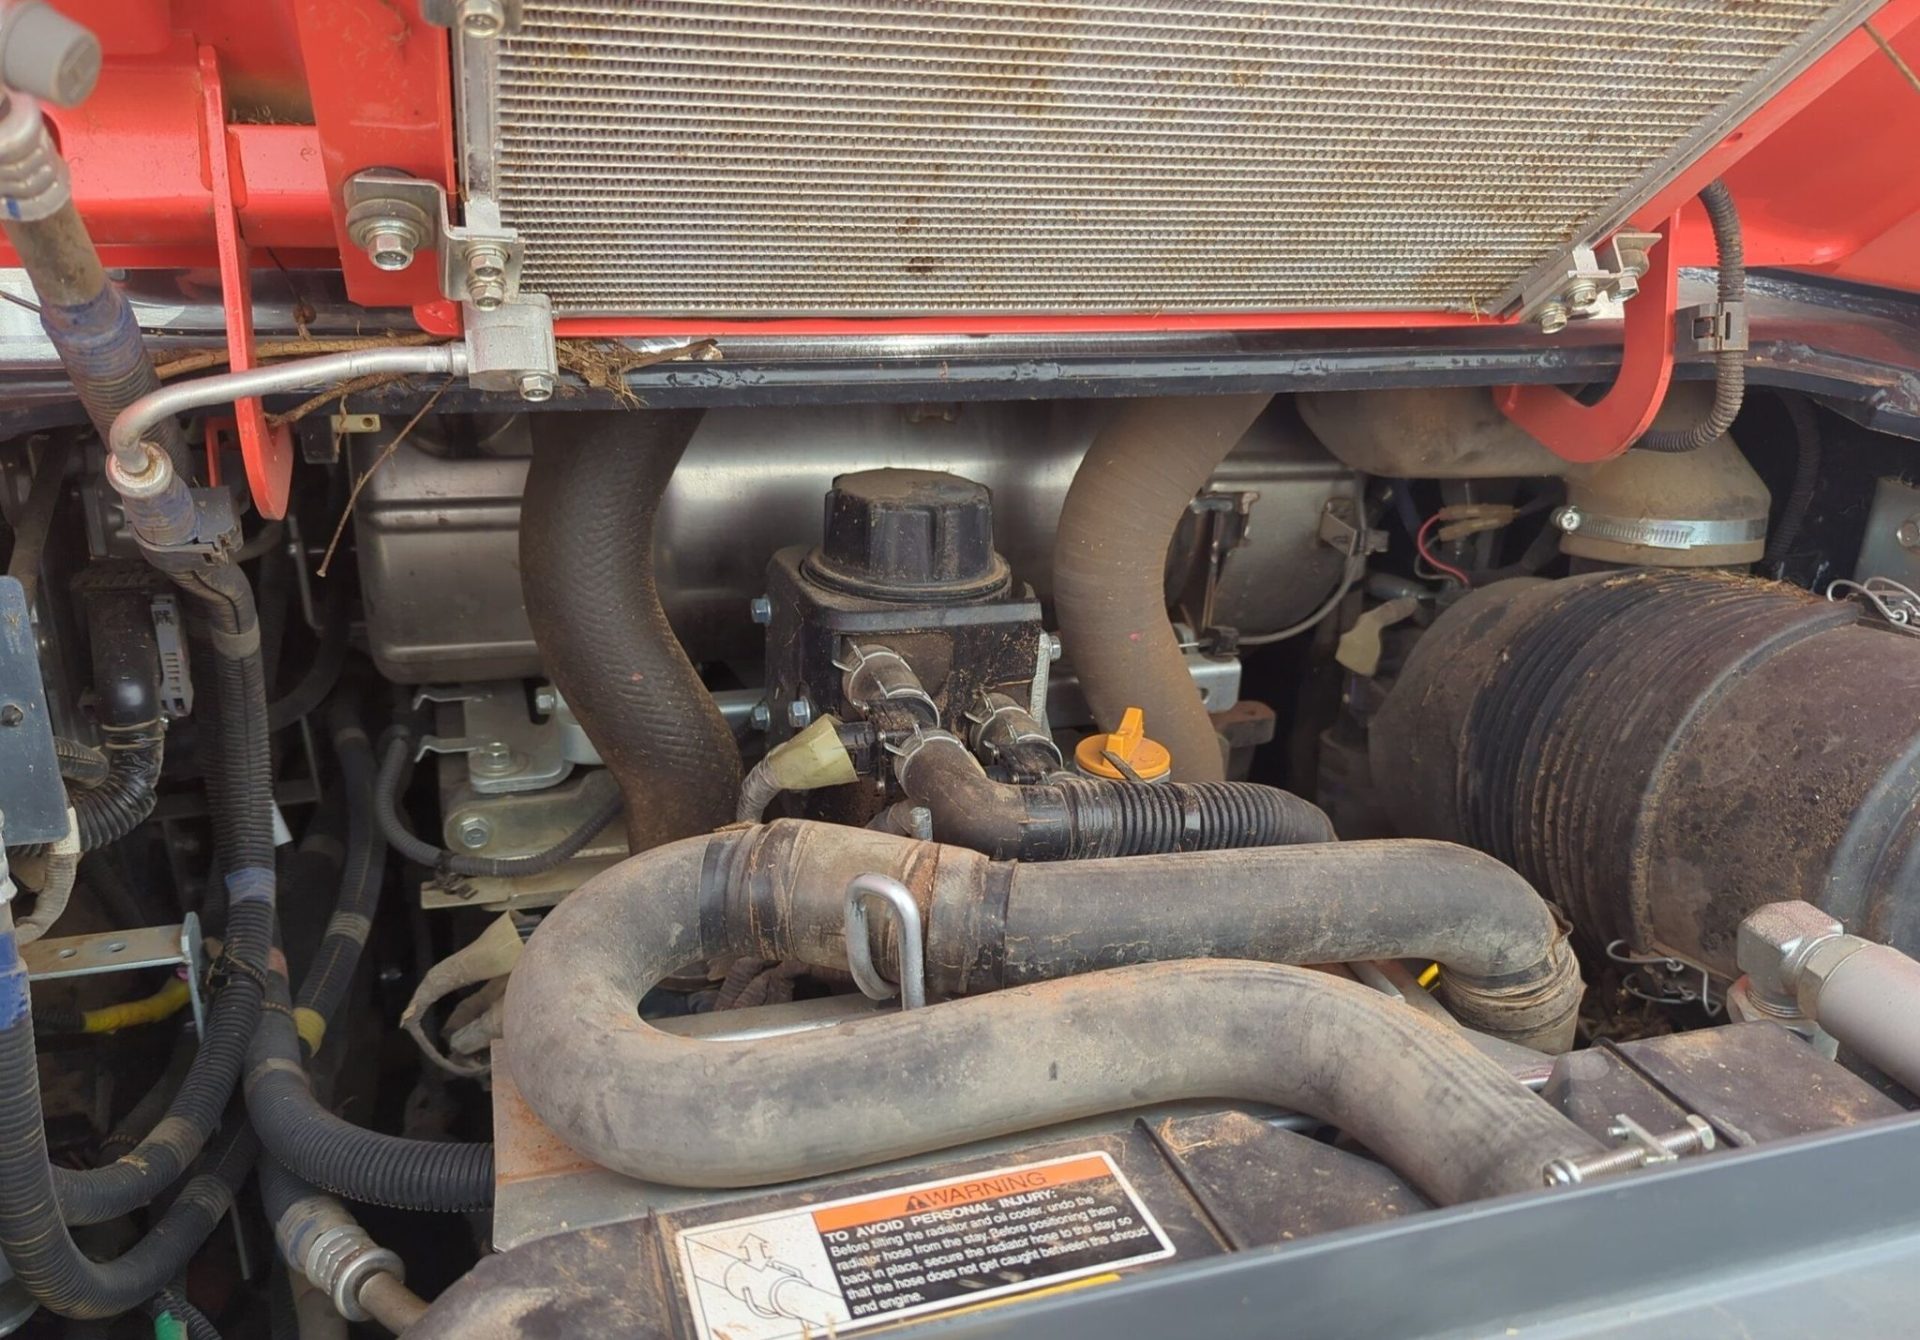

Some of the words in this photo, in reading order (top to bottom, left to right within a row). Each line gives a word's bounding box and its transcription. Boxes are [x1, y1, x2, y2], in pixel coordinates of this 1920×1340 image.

[824, 1231, 849, 1243] TO
[856, 1219, 904, 1238] AVOID
[910, 1202, 995, 1226] PERSONAL
[998, 1189, 1058, 1208] INJURY:
[924, 1171, 1047, 1205] WARNING
[830, 1241, 870, 1257] Before
[870, 1234, 904, 1249] tilting
[903, 1229, 924, 1241] the
[925, 1221, 968, 1237] radiator
[969, 1215, 993, 1228] and
[993, 1212, 1008, 1224] oil
[1008, 1206, 1047, 1220] cooler,
[1047, 1199, 1076, 1213] undo
[1075, 1196, 1095, 1206] the
[836, 1253, 882, 1271] radiator
[882, 1247, 913, 1261] hose
[913, 1241, 942, 1255] from
[941, 1236, 962, 1249] the
[963, 1232, 990, 1244] stay.
[989, 1224, 1028, 1239] Before
[1029, 1211, 1089, 1232] positioning
[1087, 1205, 1117, 1218] them
[840, 1270, 872, 1286] back
[872, 1267, 886, 1279] in
[885, 1261, 923, 1278] place,
[924, 1252, 964, 1267] secure
[964, 1247, 985, 1259] the
[986, 1238, 1029, 1254] radiator
[1029, 1232, 1060, 1245] hose
[1059, 1229, 1073, 1239] to
[1072, 1225, 1093, 1236] the
[1093, 1219, 1117, 1232] stay
[1117, 1216, 1133, 1227] so
[846, 1286, 872, 1300] that
[872, 1281, 894, 1294] the
[893, 1275, 926, 1290] hose
[926, 1267, 958, 1282] does
[957, 1263, 979, 1275] not
[979, 1258, 1000, 1273] get
[1000, 1249, 1041, 1264] caught
[1039, 1240, 1091, 1258] between
[1089, 1235, 1110, 1246] the
[1109, 1225, 1150, 1240] shroud
[852, 1299, 878, 1315] and
[878, 1291, 925, 1308] engine.
